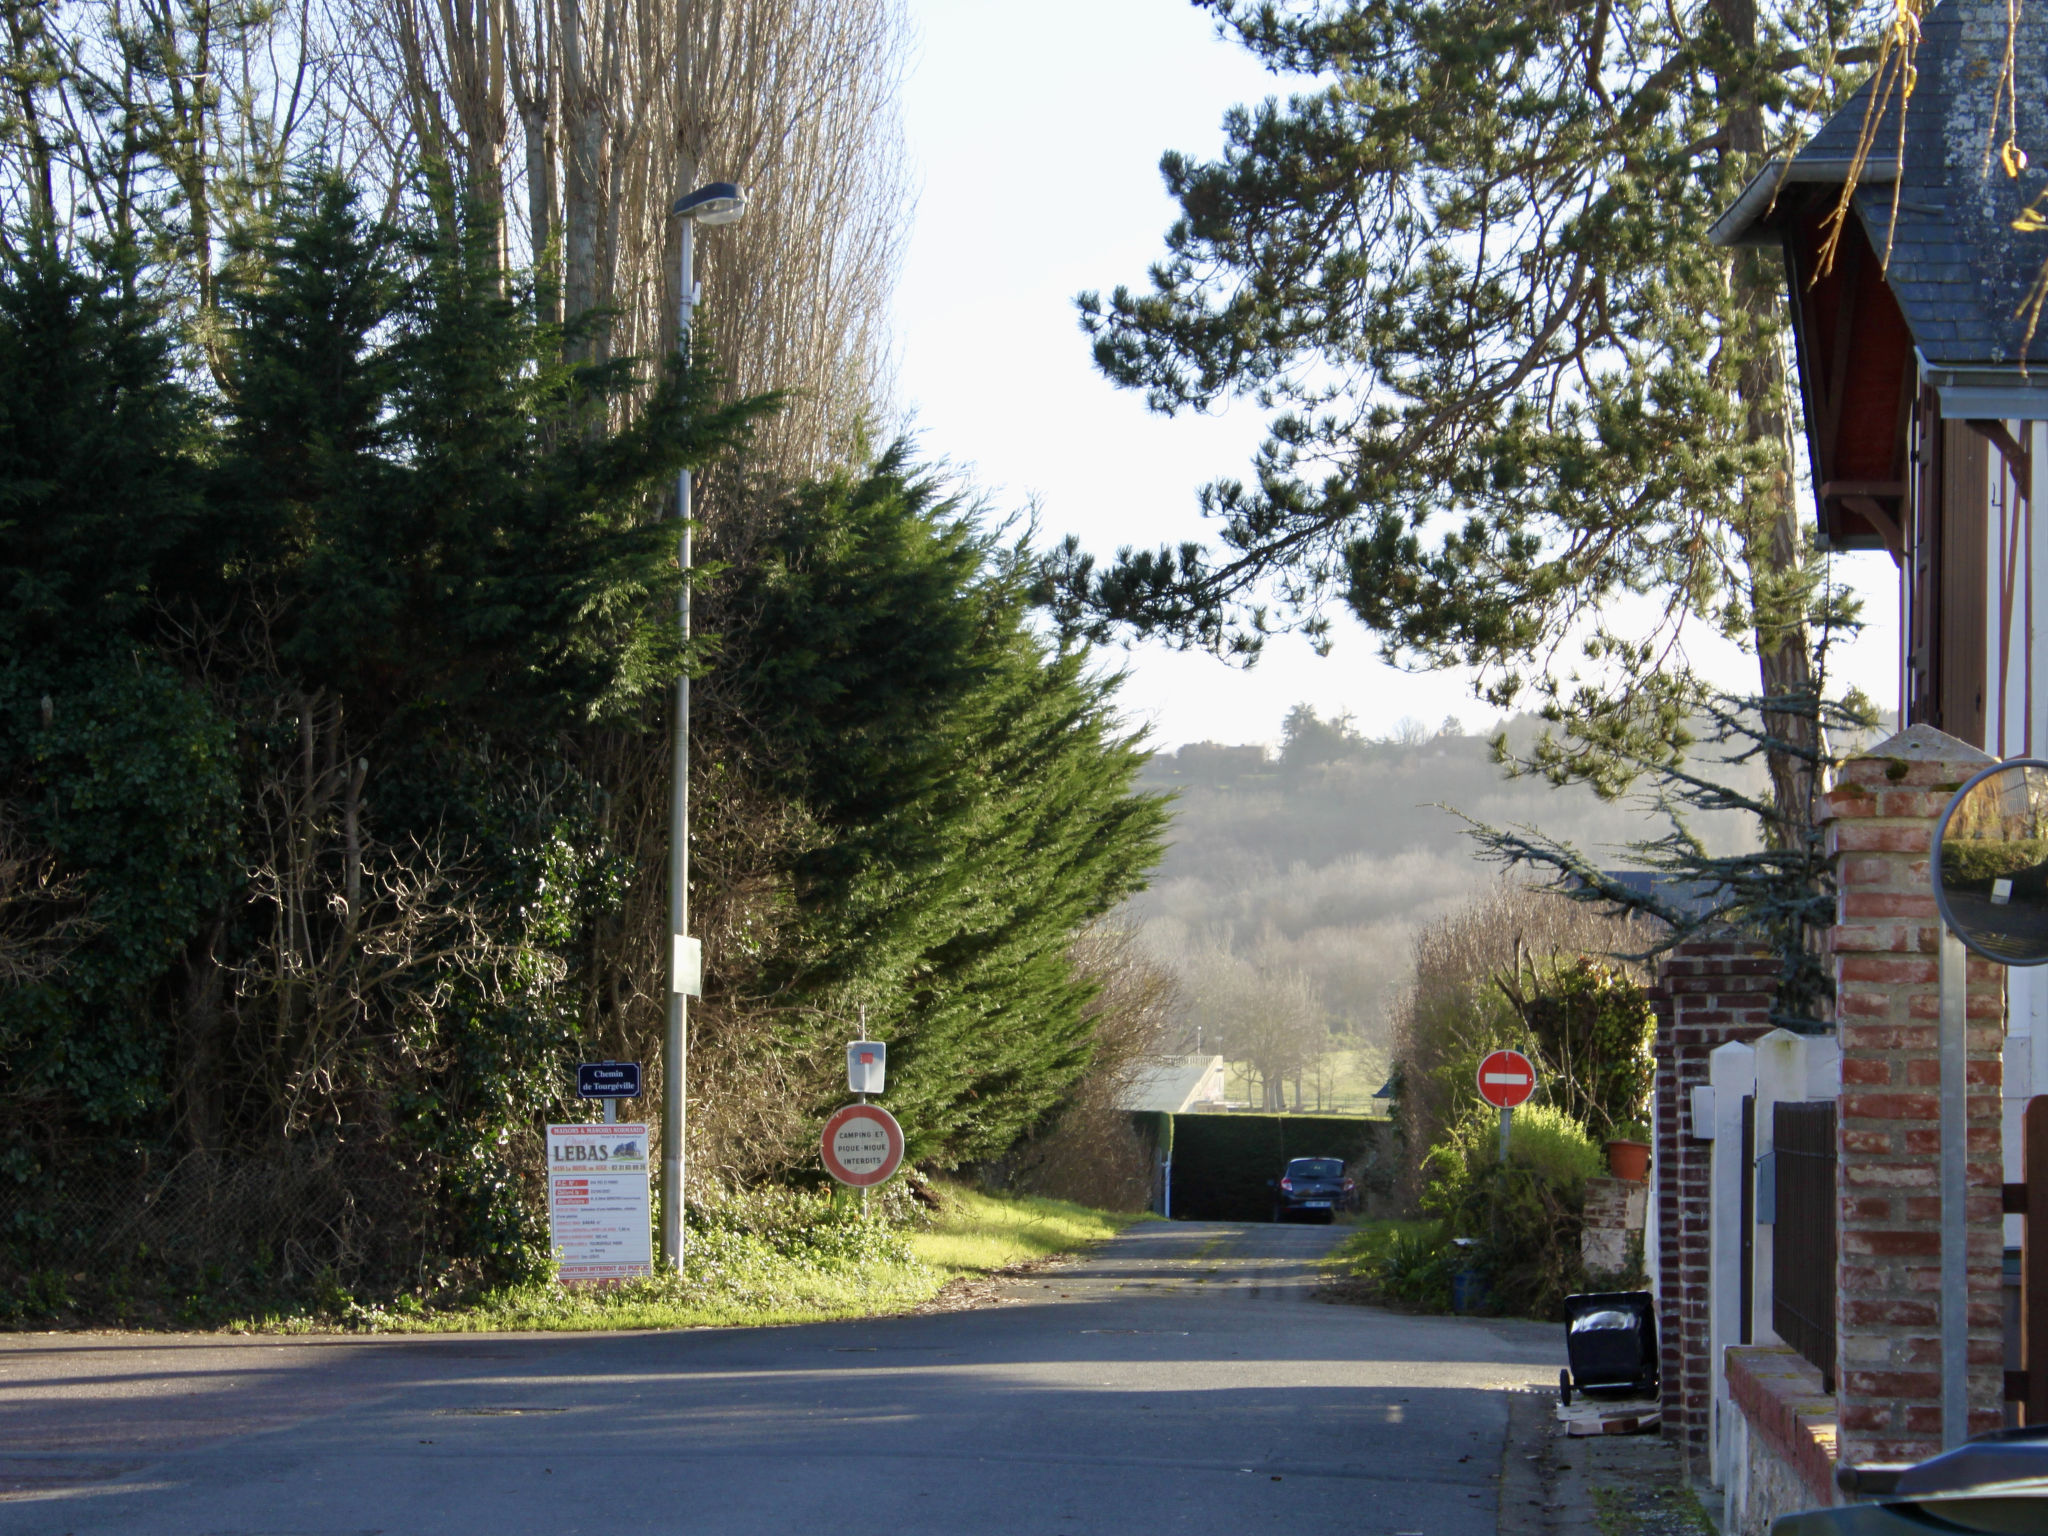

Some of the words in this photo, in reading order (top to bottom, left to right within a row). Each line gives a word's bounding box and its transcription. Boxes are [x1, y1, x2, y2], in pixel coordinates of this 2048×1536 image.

[594, 1070, 623, 1078] Chemin
[583, 1083, 592, 1091] de
[593, 1081, 635, 1092] Tourgéville
[839, 1131, 872, 1139] CAMPING
[838, 1144, 886, 1152] PIQUE-NIQUE
[553, 1144, 609, 1162] LEBAS
[844, 1157, 881, 1165] INTERDITS
